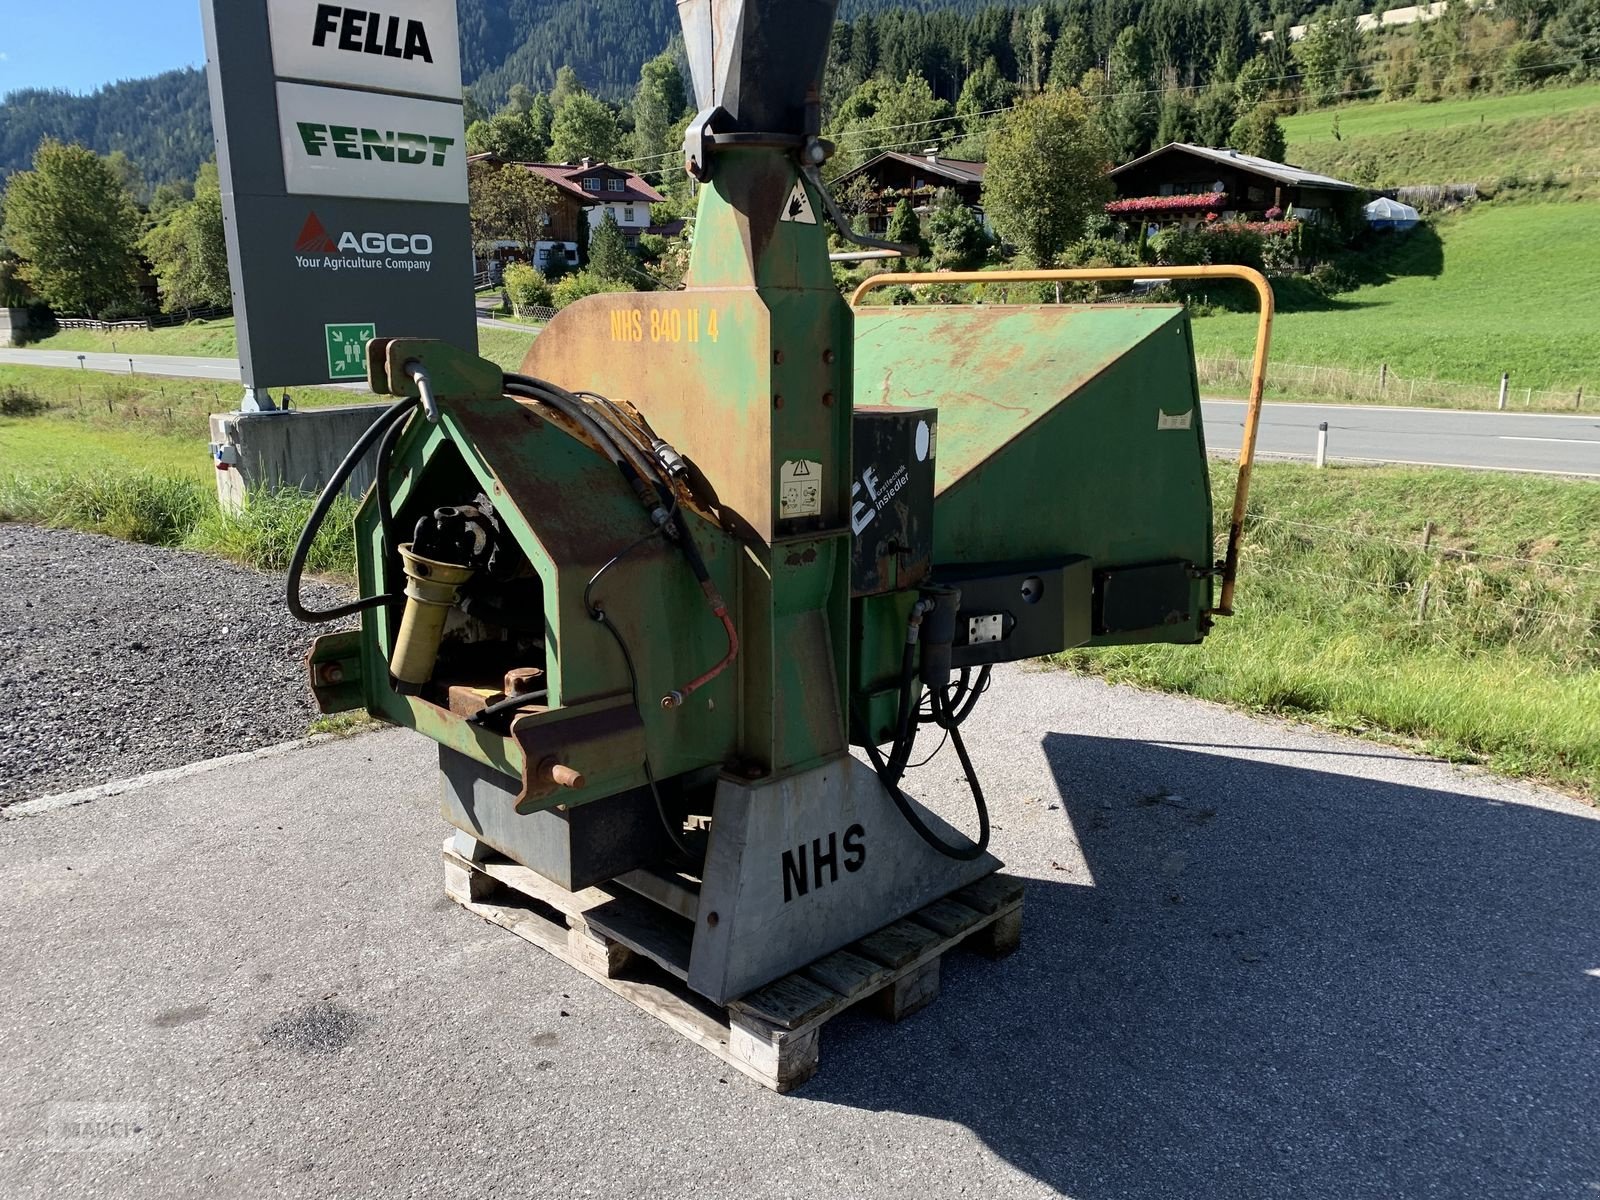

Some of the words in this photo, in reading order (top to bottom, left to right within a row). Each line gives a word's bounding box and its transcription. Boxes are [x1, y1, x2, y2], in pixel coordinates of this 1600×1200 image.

[312, 3, 433, 64] FELLA
[296, 121, 455, 167] FENDT
[337, 231, 433, 255] AGCO
[295, 256, 321, 268] Your
[323, 256, 382, 271] Agriculture
[385, 257, 431, 272] Company
[610, 308, 643, 342] NHS
[650, 308, 681, 343] 840
[707, 308, 719, 343] 4
[781, 823, 866, 903] NHS
